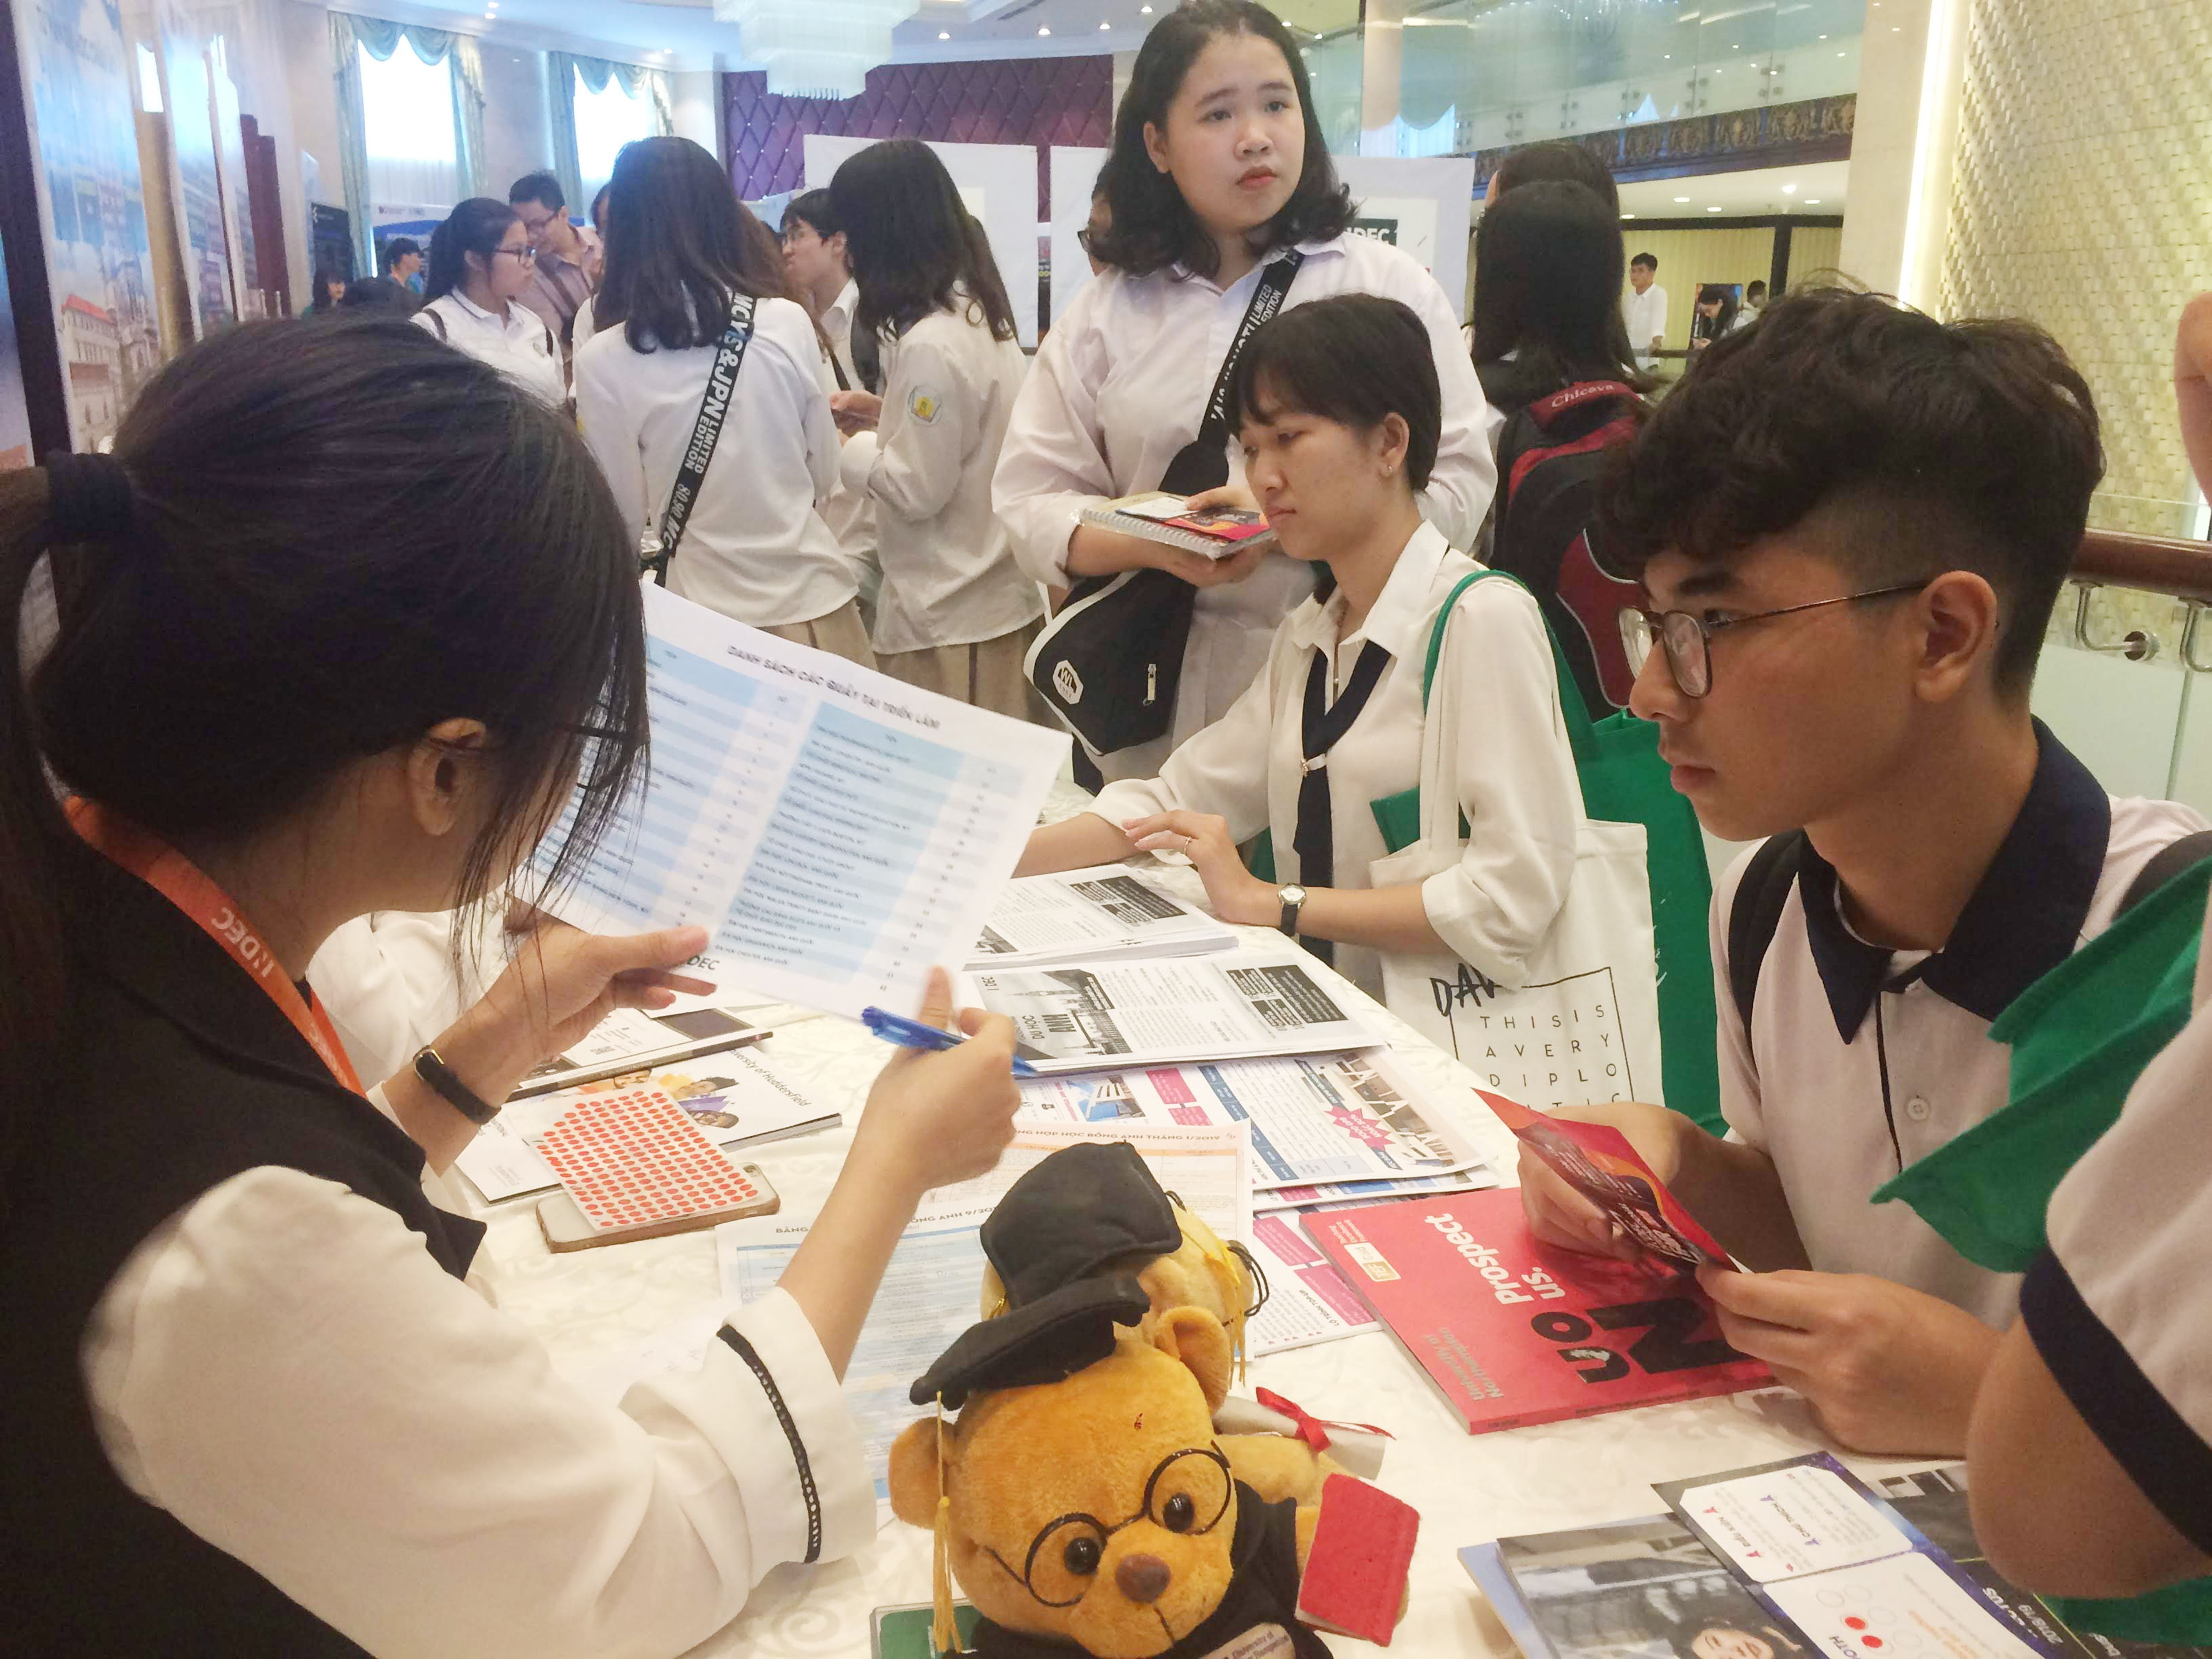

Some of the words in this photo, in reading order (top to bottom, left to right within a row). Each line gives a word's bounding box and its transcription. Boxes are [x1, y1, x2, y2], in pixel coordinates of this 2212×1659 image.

[1252, 284, 1272, 319] LIMITED
[1261, 290, 1282, 322] EDITION
[684, 415, 710, 470] EDITION
[694, 420, 719, 475] LIMITED
[1022, 1015, 1041, 1030] HỌC
[1030, 1031, 1045, 1040] DU
[1041, 1013, 1077, 1032] ANH
[762, 1073, 812, 1106] Huddersfield
[939, 1212, 963, 1220] ANH
[1369, 1263, 1390, 1279] TEF
[1424, 1213, 1535, 1304] Prospect
[1521, 1267, 1566, 1299] us.
